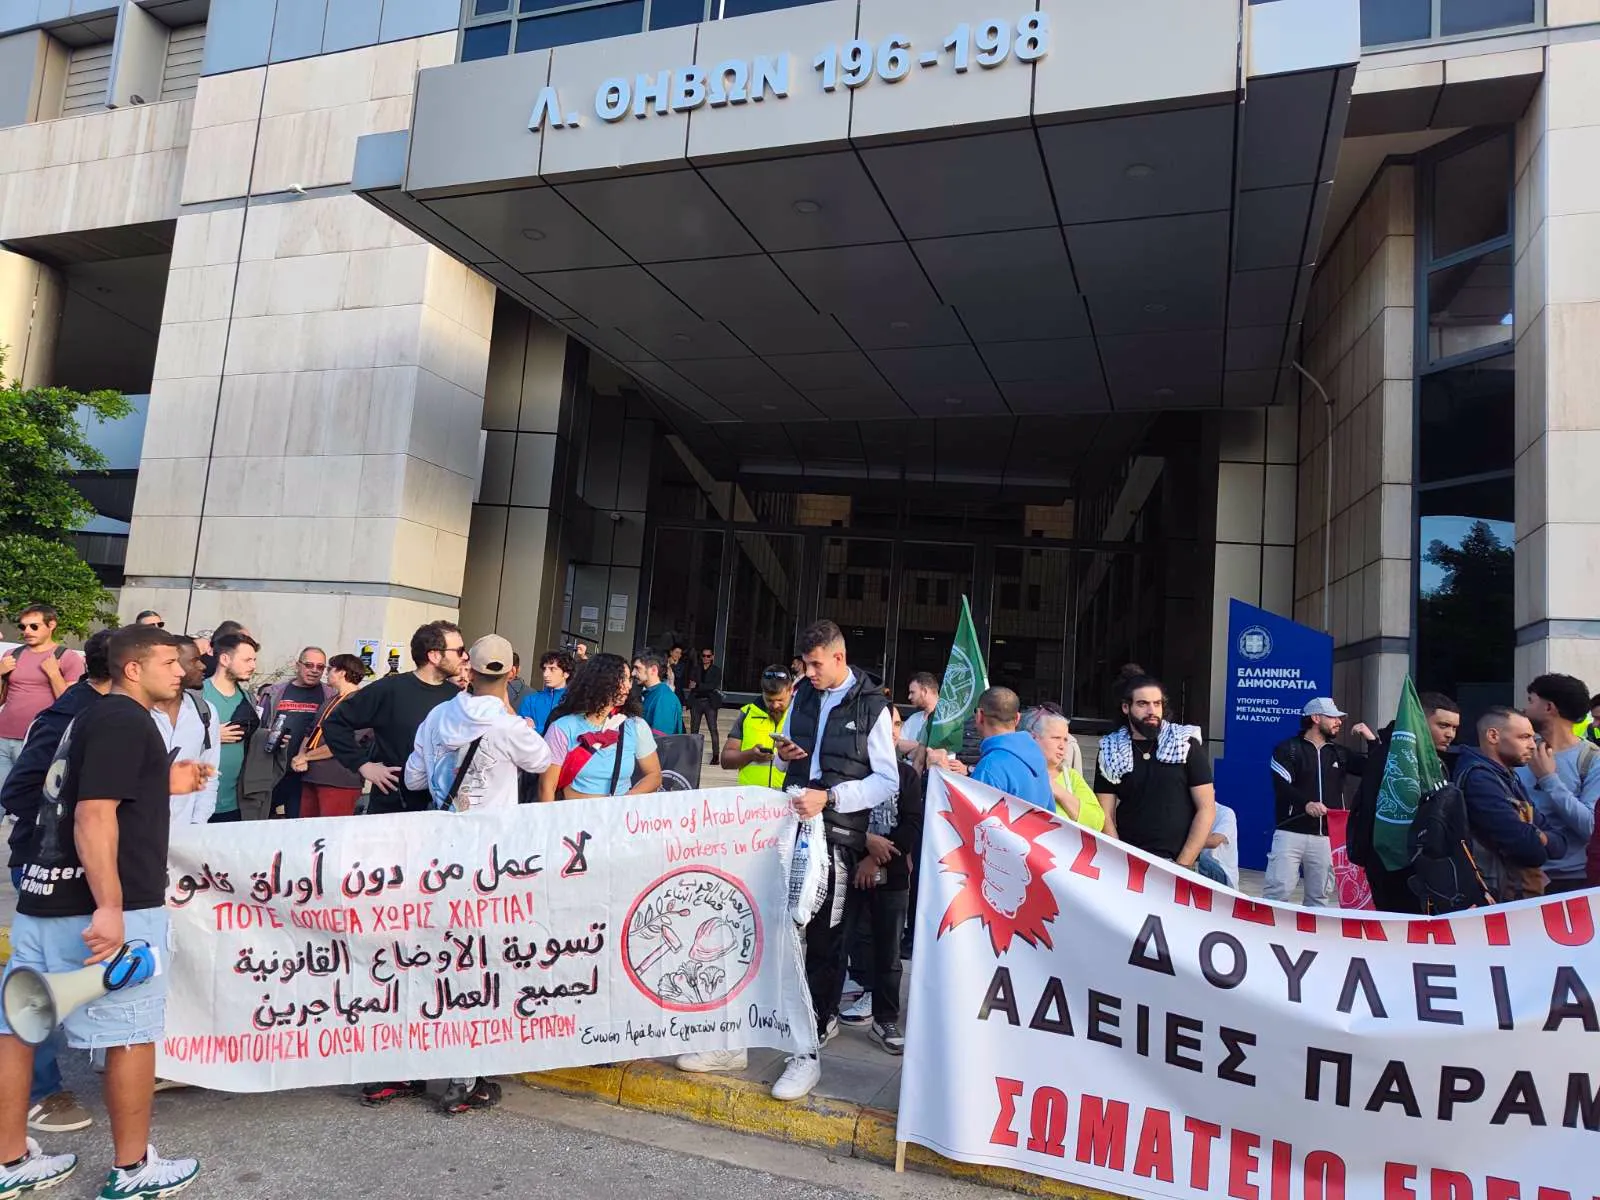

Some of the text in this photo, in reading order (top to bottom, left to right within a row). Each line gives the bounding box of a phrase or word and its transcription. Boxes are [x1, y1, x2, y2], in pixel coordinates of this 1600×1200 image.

[528, 11, 1050, 132] Λ. ΘΗΒΩΝ 196-198
[1237, 667, 1300, 678] ΕΛΛΗΝΙΚΗ
[1237, 678, 1317, 690] ΔΗΜΟΚΡΑΤΙΑ
[1236, 697, 1279, 706] ΥΠΟΥΡΓΕΙΟ
[1236, 706, 1302, 715] ΜΕΤΑΝΑΣΤΕΥΣΗΣ
[1251, 715, 1281, 723] ΑΣΥΛΟΥ
[626, 807, 672, 834] Union
[680, 808, 697, 834] of
[702, 799, 735, 827] Arab
[473, 843, 543, 896] عمل
[561, 831, 592, 878] لا
[666, 836, 727, 863] Workers
[734, 840, 747, 855] in
[250, 838, 325, 906] أوراق
[341, 860, 405, 900] دون
[418, 857, 464, 895] من
[213, 902, 284, 932] ΠΟΤΕ
[372, 901, 435, 932] ΧΩΡΙΣ
[448, 892, 534, 929] ΧΑΡΤΙΑ!
[232, 922, 607, 984] تسوية الأوضاع القانونية
[1128, 913, 1600, 1032] ΔΟΥΛΕΙΑ
[253, 965, 599, 1030] لجميع العمال المهاجرين
[164, 1028, 309, 1065] ΝΟΜΙΜΟΠΟΙΗΣΗ
[318, 1022, 364, 1057] ΟΛΩΝ
[371, 1022, 402, 1051] ΤΩΝ
[408, 1017, 513, 1052] ΜΕΤΑΝΑΣΤΩΝ
[977, 965, 1256, 1087] ΑΔΕΙΕΣ
